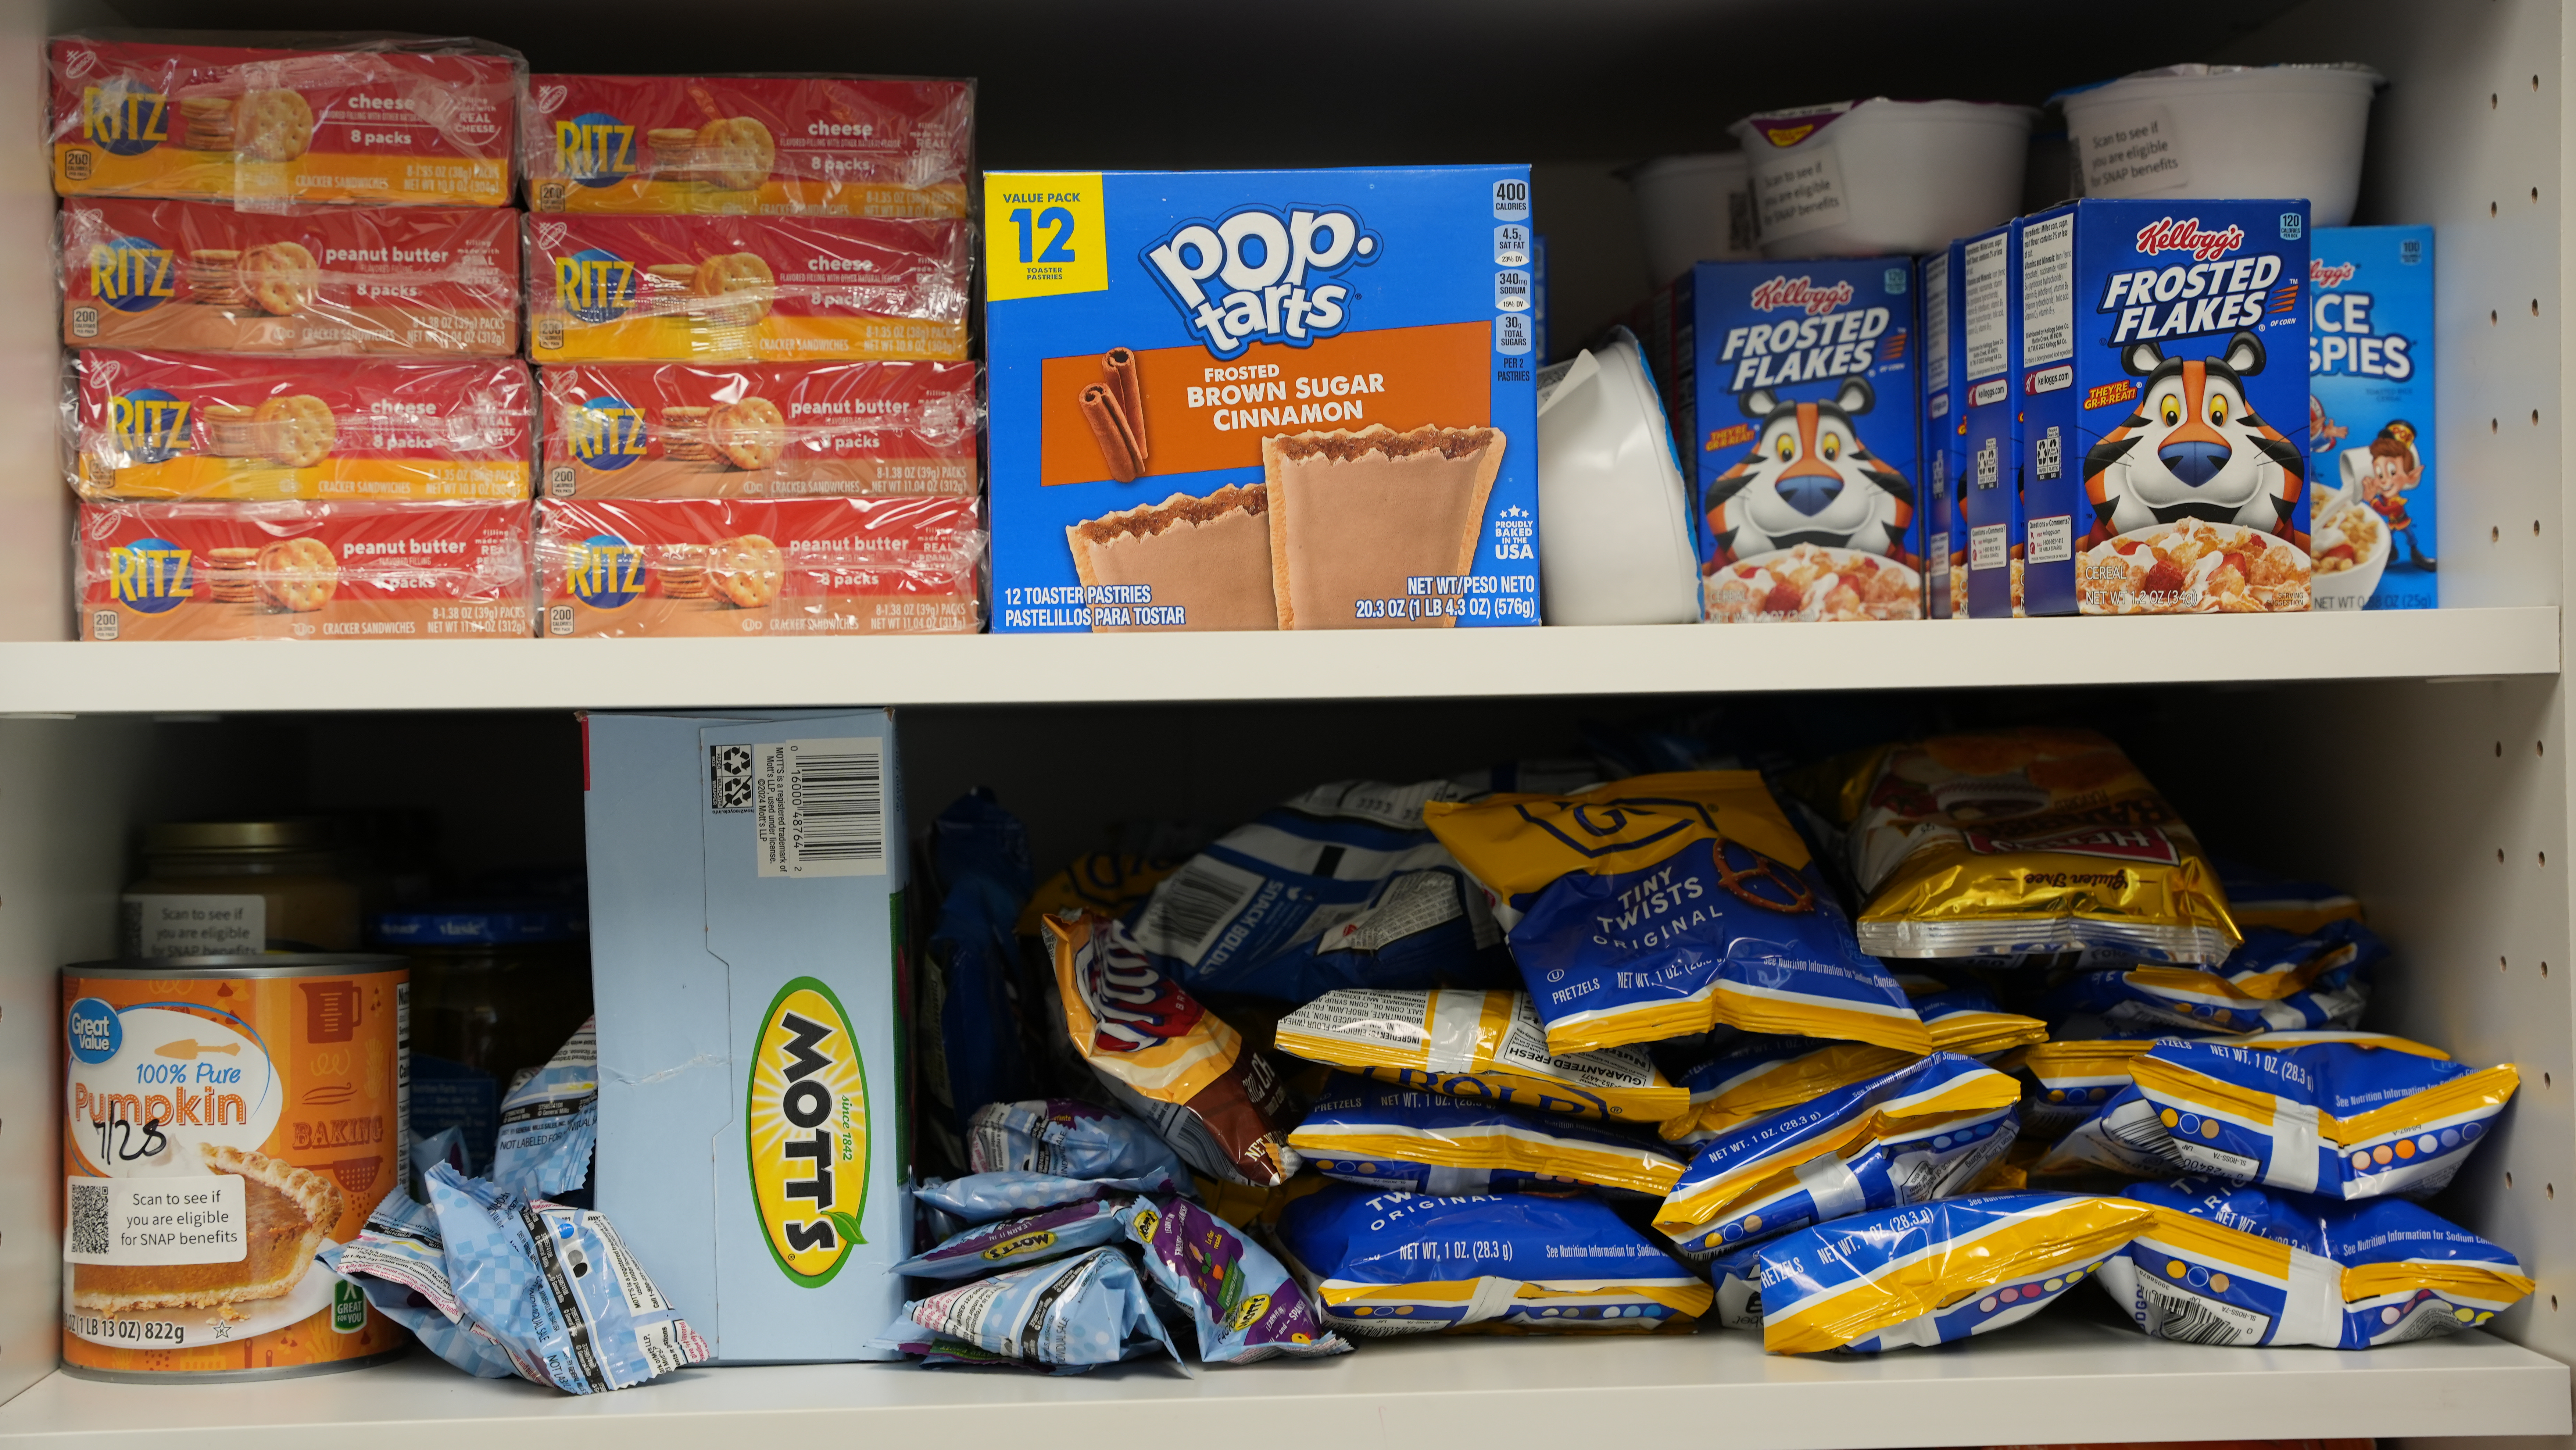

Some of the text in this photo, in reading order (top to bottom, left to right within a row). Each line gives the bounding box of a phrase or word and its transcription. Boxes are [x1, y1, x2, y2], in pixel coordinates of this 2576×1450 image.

[348, 94, 415, 111] cheese
[83, 86, 167, 143] RITZ
[350, 130, 412, 146] 8 packs
[808, 121, 872, 136] cheese
[556, 120, 636, 173] RITZ
[1003, 193, 1080, 203] VALUE PACK
[1497, 183, 1525, 200] 400
[1496, 203, 1526, 211] CALORIES
[2283, 215, 2299, 226] 120
[1009, 207, 1075, 263] 12
[2138, 217, 2243, 260] Kellogg's
[2404, 242, 2419, 252] 100
[91, 242, 174, 299] RITZ
[1500, 273, 1527, 286] 340mg
[556, 256, 635, 310] RITZ
[2103, 256, 2281, 310] FROSTED
[1753, 277, 1853, 313] Kellogg's
[1194, 283, 1347, 351] tarts
[2113, 292, 2266, 343] FLAKES
[1722, 307, 1889, 361] FROSTED
[1205, 364, 1280, 382] FROSTED
[1504, 358, 1523, 368] PER 2
[1732, 340, 1875, 390] FLAKES
[1498, 371, 1530, 381] PASTRIES
[2038, 372, 2069, 386] kelloggs.com
[1187, 374, 1385, 408] BROWN SUGAR
[2085, 388, 2136, 410] GR-R-REAT!
[2090, 381, 2128, 400] THEY'RE
[107, 396, 191, 451] RITZ
[1213, 400, 1363, 431] CINNAMON
[567, 404, 647, 458] RITZ
[1496, 528, 1532, 537] BAKED
[2049, 517, 2070, 526] Comments?
[343, 539, 466, 558] peanut butter
[790, 536, 909, 554] peanut butter
[1495, 544, 1534, 560] USA
[109, 546, 193, 602] RITZ
[567, 543, 645, 597] RITZ
[2085, 566, 2127, 580] CEREAL
[1005, 585, 1151, 604] 12 TOASTER PASTRIES
[1407, 575, 1534, 595] NET WT/PESO NETO
[1356, 597, 1535, 621] 20.3 OZ (1 LB 4.3 OZ) (576g)
[2085, 590, 2197, 607] NET WT 1.2 OZ (34g)
[876, 604, 966, 617] 8-1.38 OZ (39g) PACKS
[1006, 606, 1185, 626] PASTELILLOS PARA TOSTAR
[776, 747, 784, 774] MOTT'S
[791, 771, 802, 849] 16000 48764
[1618, 867, 1672, 910] TINY
[2024, 870, 2128, 890] Gluten Free
[1597, 877, 1703, 933] TWISTS
[1593, 905, 1722, 949] ORIGINAL
[1552, 972, 1654, 1005] PRETZELS NET WT.
[72, 1013, 110, 1036] Great
[79, 1035, 110, 1051] Value
[137, 1062, 241, 1084] 100% Pure
[75, 1082, 246, 1126] Pumpkin
[293, 1116, 383, 1149] BAKING
[841, 1094, 852, 1161] since 1842
[500, 1140, 515, 1150] NOT
[517, 1136, 547, 1148] LABELED
[133, 1190, 221, 1206] Scan to see if
[126, 1211, 229, 1228] you are eligible
[121, 1231, 237, 1245] for SNAP benefits
[2343, 1229, 2473, 1256] See Nutrition Information for Sodium
[1400, 1240, 1513, 1262] NET WT. 1 OZ. (28.3 g)
[337, 1302, 362, 1314] GREAT
[347, 1312, 362, 1323] YOU
[77, 1316, 83, 1335] (1
[87, 1319, 98, 1335] LB
[102, 1321, 114, 1337] 13
[119, 1321, 140, 1341] OZ)
[145, 1323, 184, 1343] 822g
